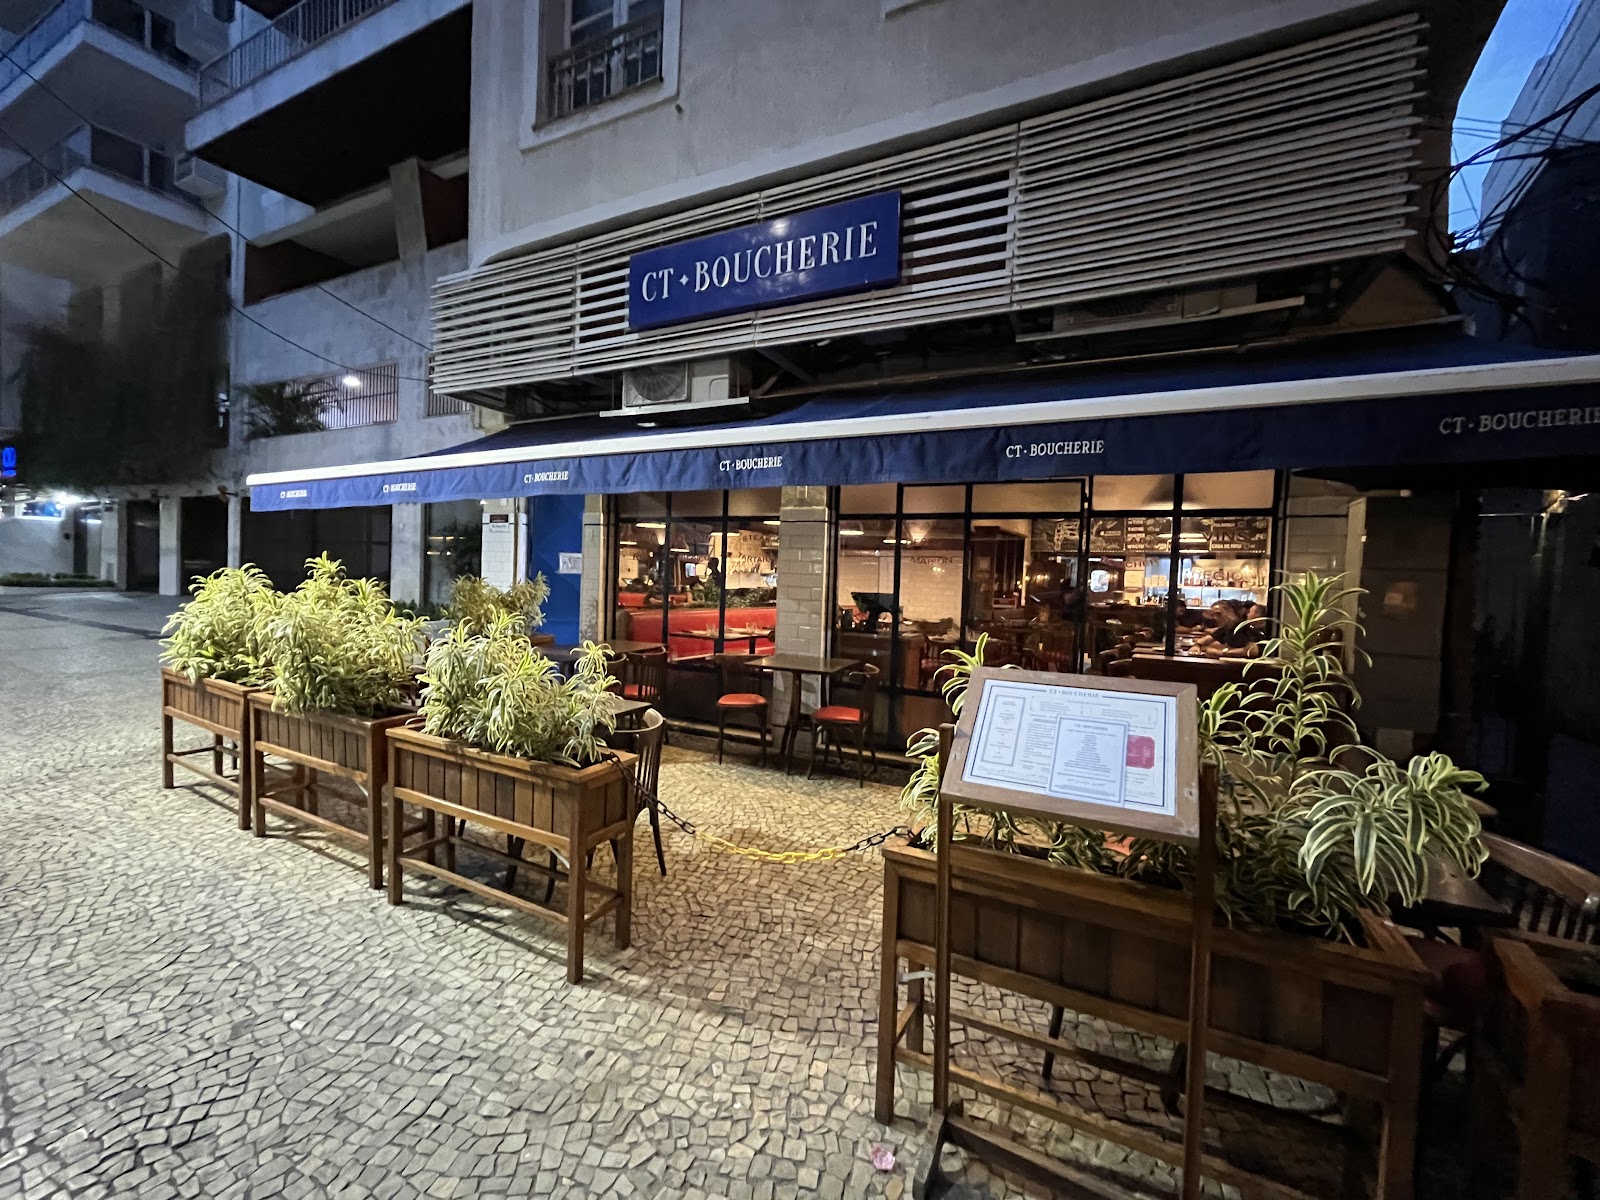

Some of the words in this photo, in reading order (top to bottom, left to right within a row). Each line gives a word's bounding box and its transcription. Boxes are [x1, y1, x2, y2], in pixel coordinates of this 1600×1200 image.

[640, 267, 674, 302] CT
[694, 220, 879, 292] BOUCHERIE
[1439, 416, 1466, 434] CT
[1478, 407, 1600, 432] BOUCHERIE
[1005, 444, 1023, 458] CT
[1029, 439, 1105, 457] BOUCHERIE
[719, 460, 731, 472] CT
[735, 456, 783, 471] BOUCHERIE
[533, 471, 569, 482] BOUCHERIE
[1201, 530, 1250, 542] VINS
